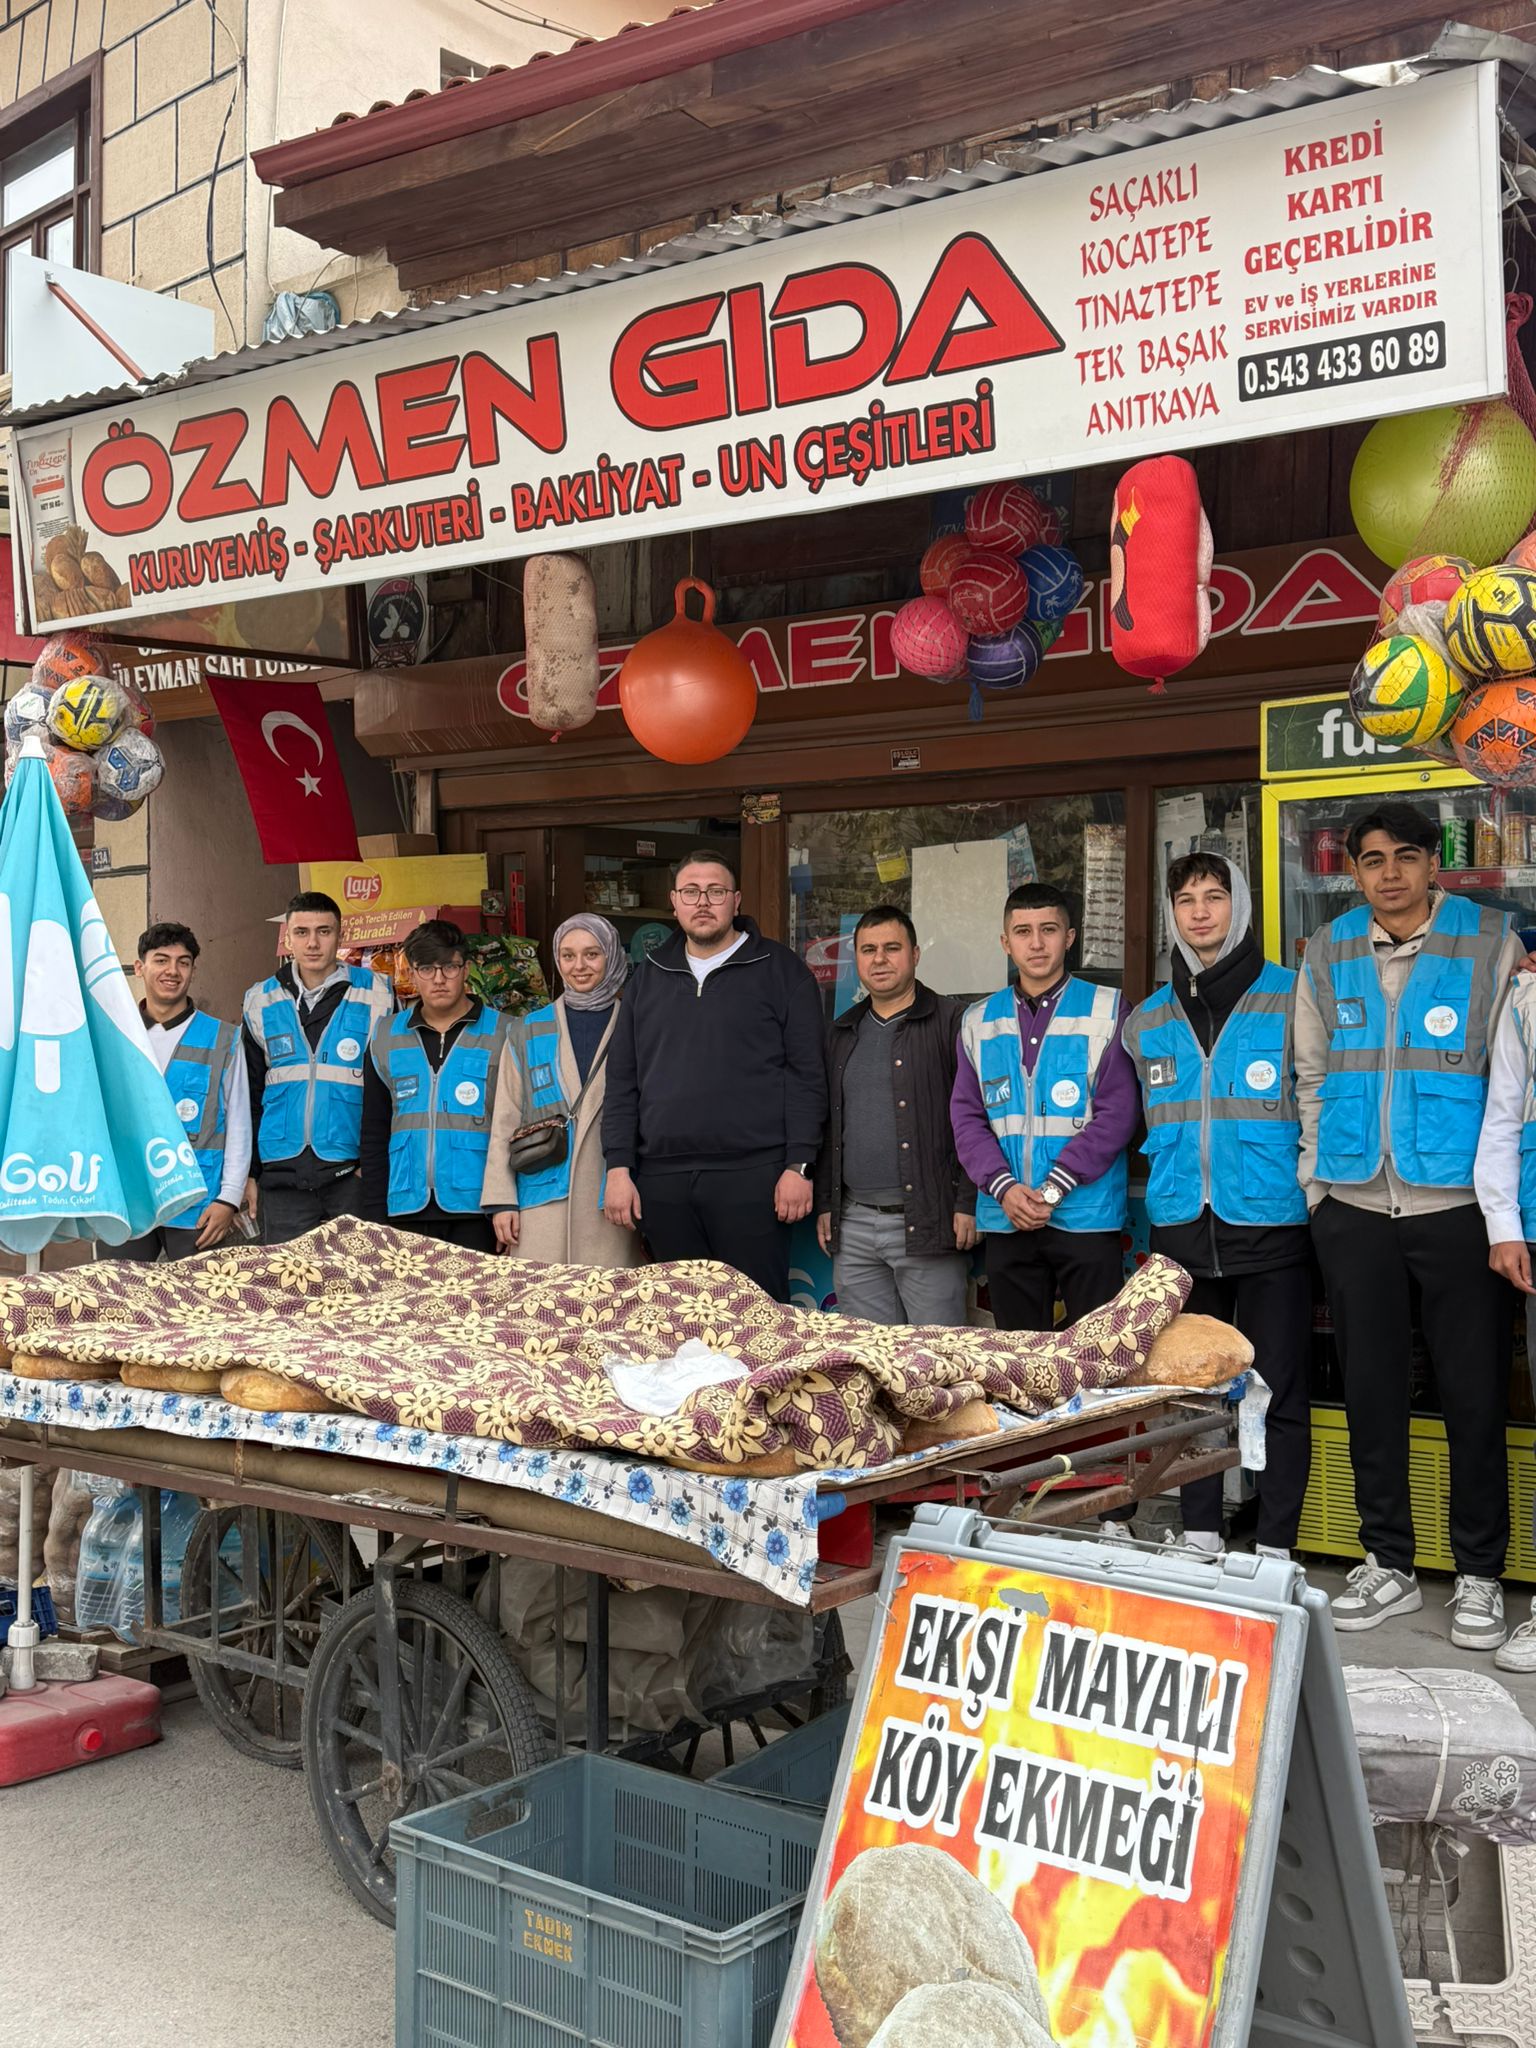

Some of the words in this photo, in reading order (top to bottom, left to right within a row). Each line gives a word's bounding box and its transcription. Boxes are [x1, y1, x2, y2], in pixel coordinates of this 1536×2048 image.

[1283, 119, 1384, 177] KREDİ
[1089, 162, 1198, 222] SAÇAKLI
[1286, 174, 1384, 222] KARTI
[1079, 215, 1213, 279] KOCATEPE
[1243, 207, 1434, 275] GEÇERLİDİR
[1074, 269, 1223, 332] TINAZTEPE
[1244, 294, 1269, 315] EV
[1274, 292, 1295, 308] ve
[1300, 283, 1319, 308] İŞ
[1323, 262, 1437, 301] YERLERİNE
[1244, 304, 1356, 341] SERVİSİMİZ
[1363, 289, 1438, 319] VARDIR
[82, 332, 567, 536] ÖZMEN
[610, 231, 1066, 432] GIDA
[1073, 344, 1126, 386] TEK
[1138, 324, 1230, 379] BAŞAK
[1243, 352, 1310, 395] 0.543
[1316, 343, 1362, 381] 433
[1369, 336, 1401, 373] 60
[1407, 330, 1440, 366] 89
[1085, 381, 1221, 438] ANITKAYA
[128, 517, 288, 597] KURUYEMİŞ
[313, 478, 483, 575] ŞARKUTERİ
[510, 452, 686, 534] BAKLİYAT
[717, 433, 785, 497] UN
[793, 377, 996, 495] ÇEŞİTLERİ
[346, 873, 379, 900] Lay's
[0, 1151, 103, 1194] Golf
[146, 1137, 197, 1178] Go
[901, 1602, 1026, 1718] EKŞİ
[1037, 1631, 1243, 1755] MAYALI
[869, 1713, 979, 1824] KÖY
[981, 1753, 1199, 1890] EKMEĞİ
[523, 1930, 573, 1963] EKMEK
